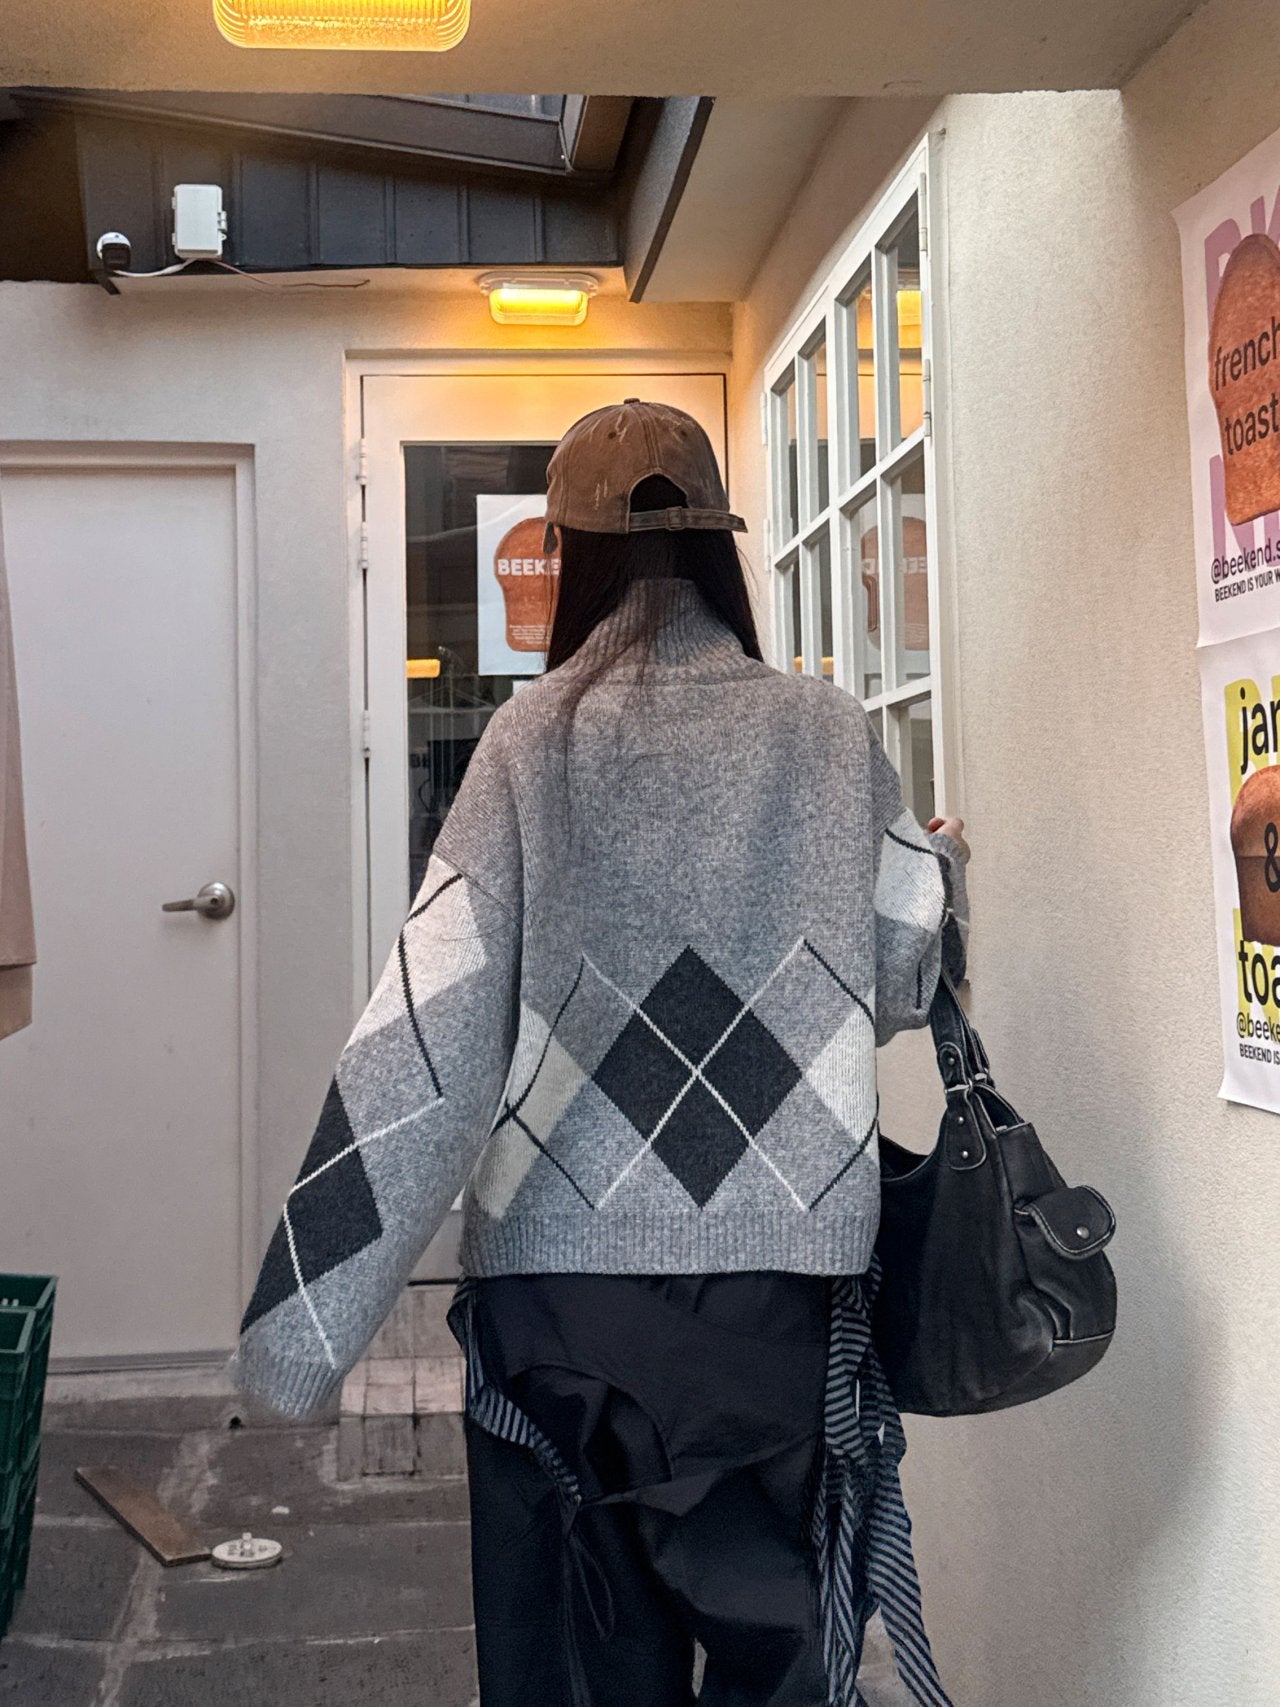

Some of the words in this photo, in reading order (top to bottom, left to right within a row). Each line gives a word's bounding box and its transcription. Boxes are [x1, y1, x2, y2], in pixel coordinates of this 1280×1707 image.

[1215, 316, 1280, 391] french
[1225, 393, 1279, 456] toast
[1215, 580, 1246, 602] BEEKEND
[1247, 577, 1254, 592] IS
[1254, 570, 1274, 589] YOUR
[1264, 822, 1280, 893] &
[1239, 1043, 1272, 1063] BEEKEND
